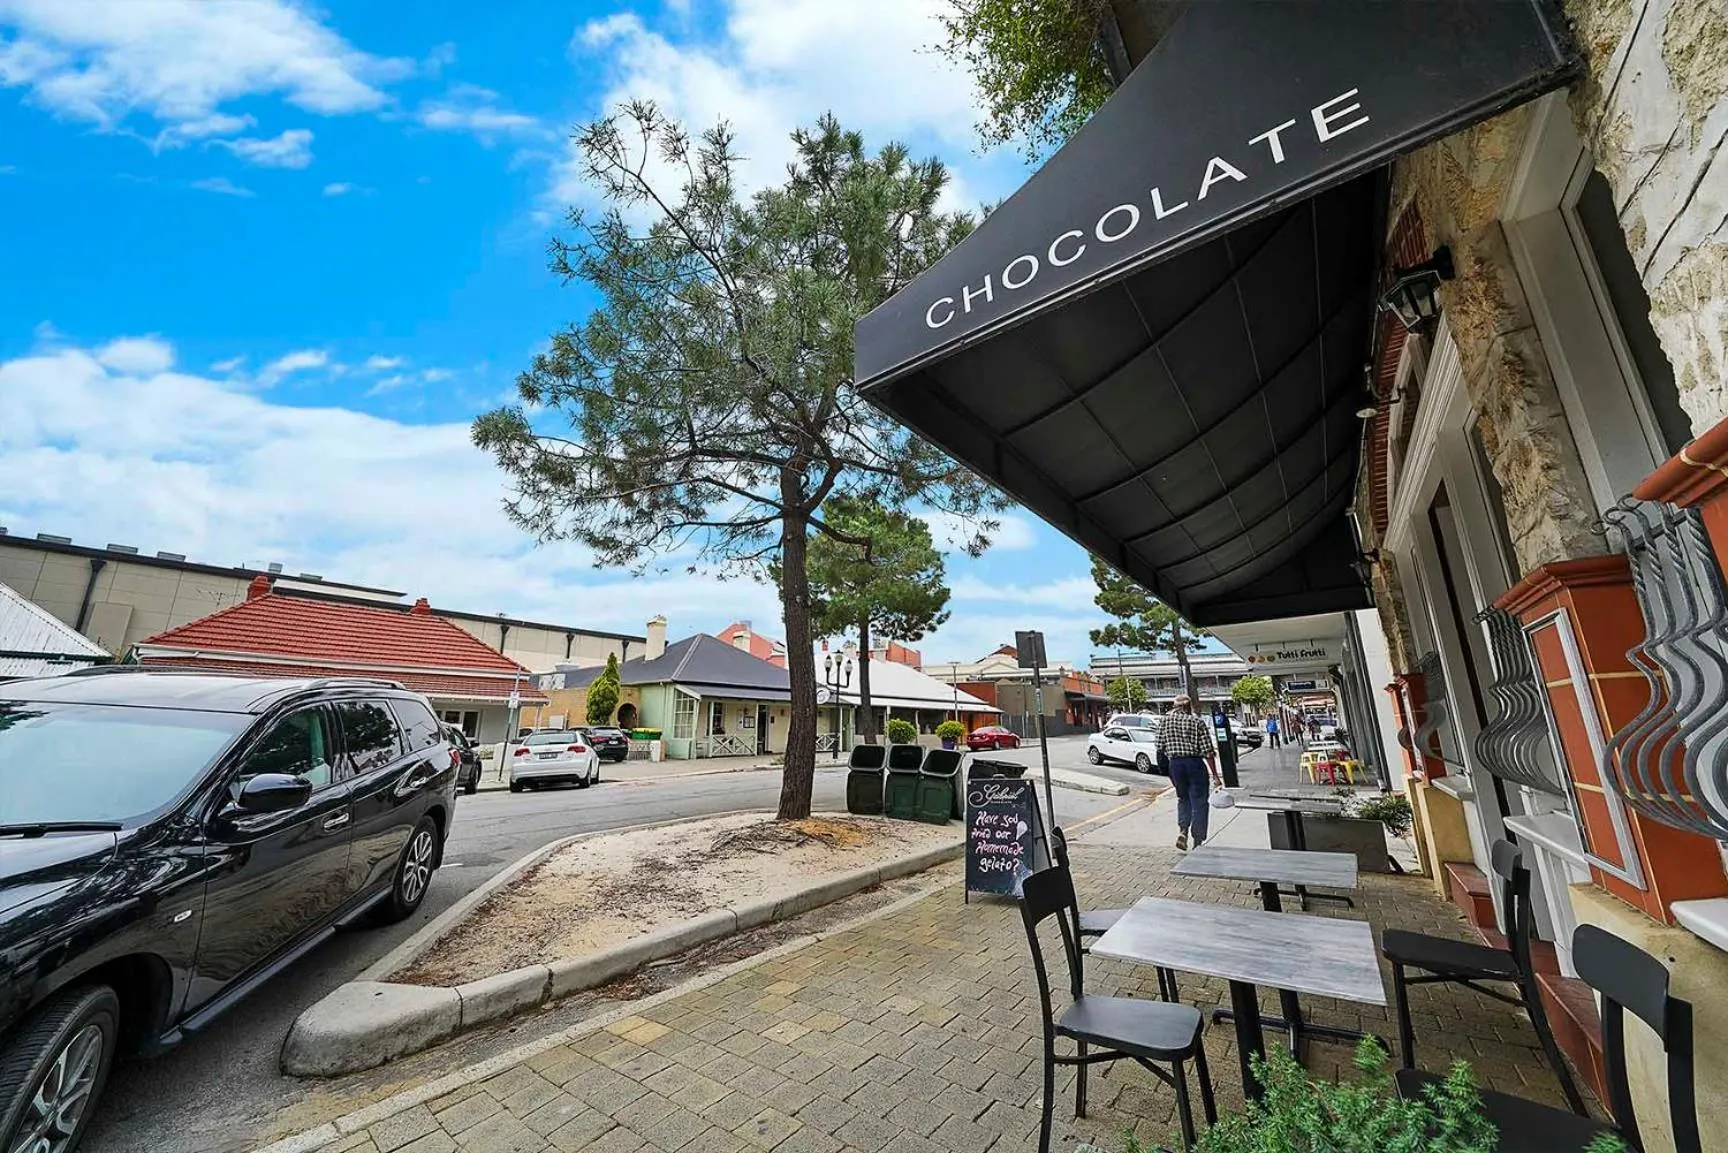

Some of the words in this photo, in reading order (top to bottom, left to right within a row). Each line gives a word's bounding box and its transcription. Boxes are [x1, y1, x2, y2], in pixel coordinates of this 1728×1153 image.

[925, 87, 1370, 329] CHOCOLATE
[1277, 649, 1299, 660] Tutti
[976, 810, 998, 825] Have
[975, 840, 1024, 855] Homemade
